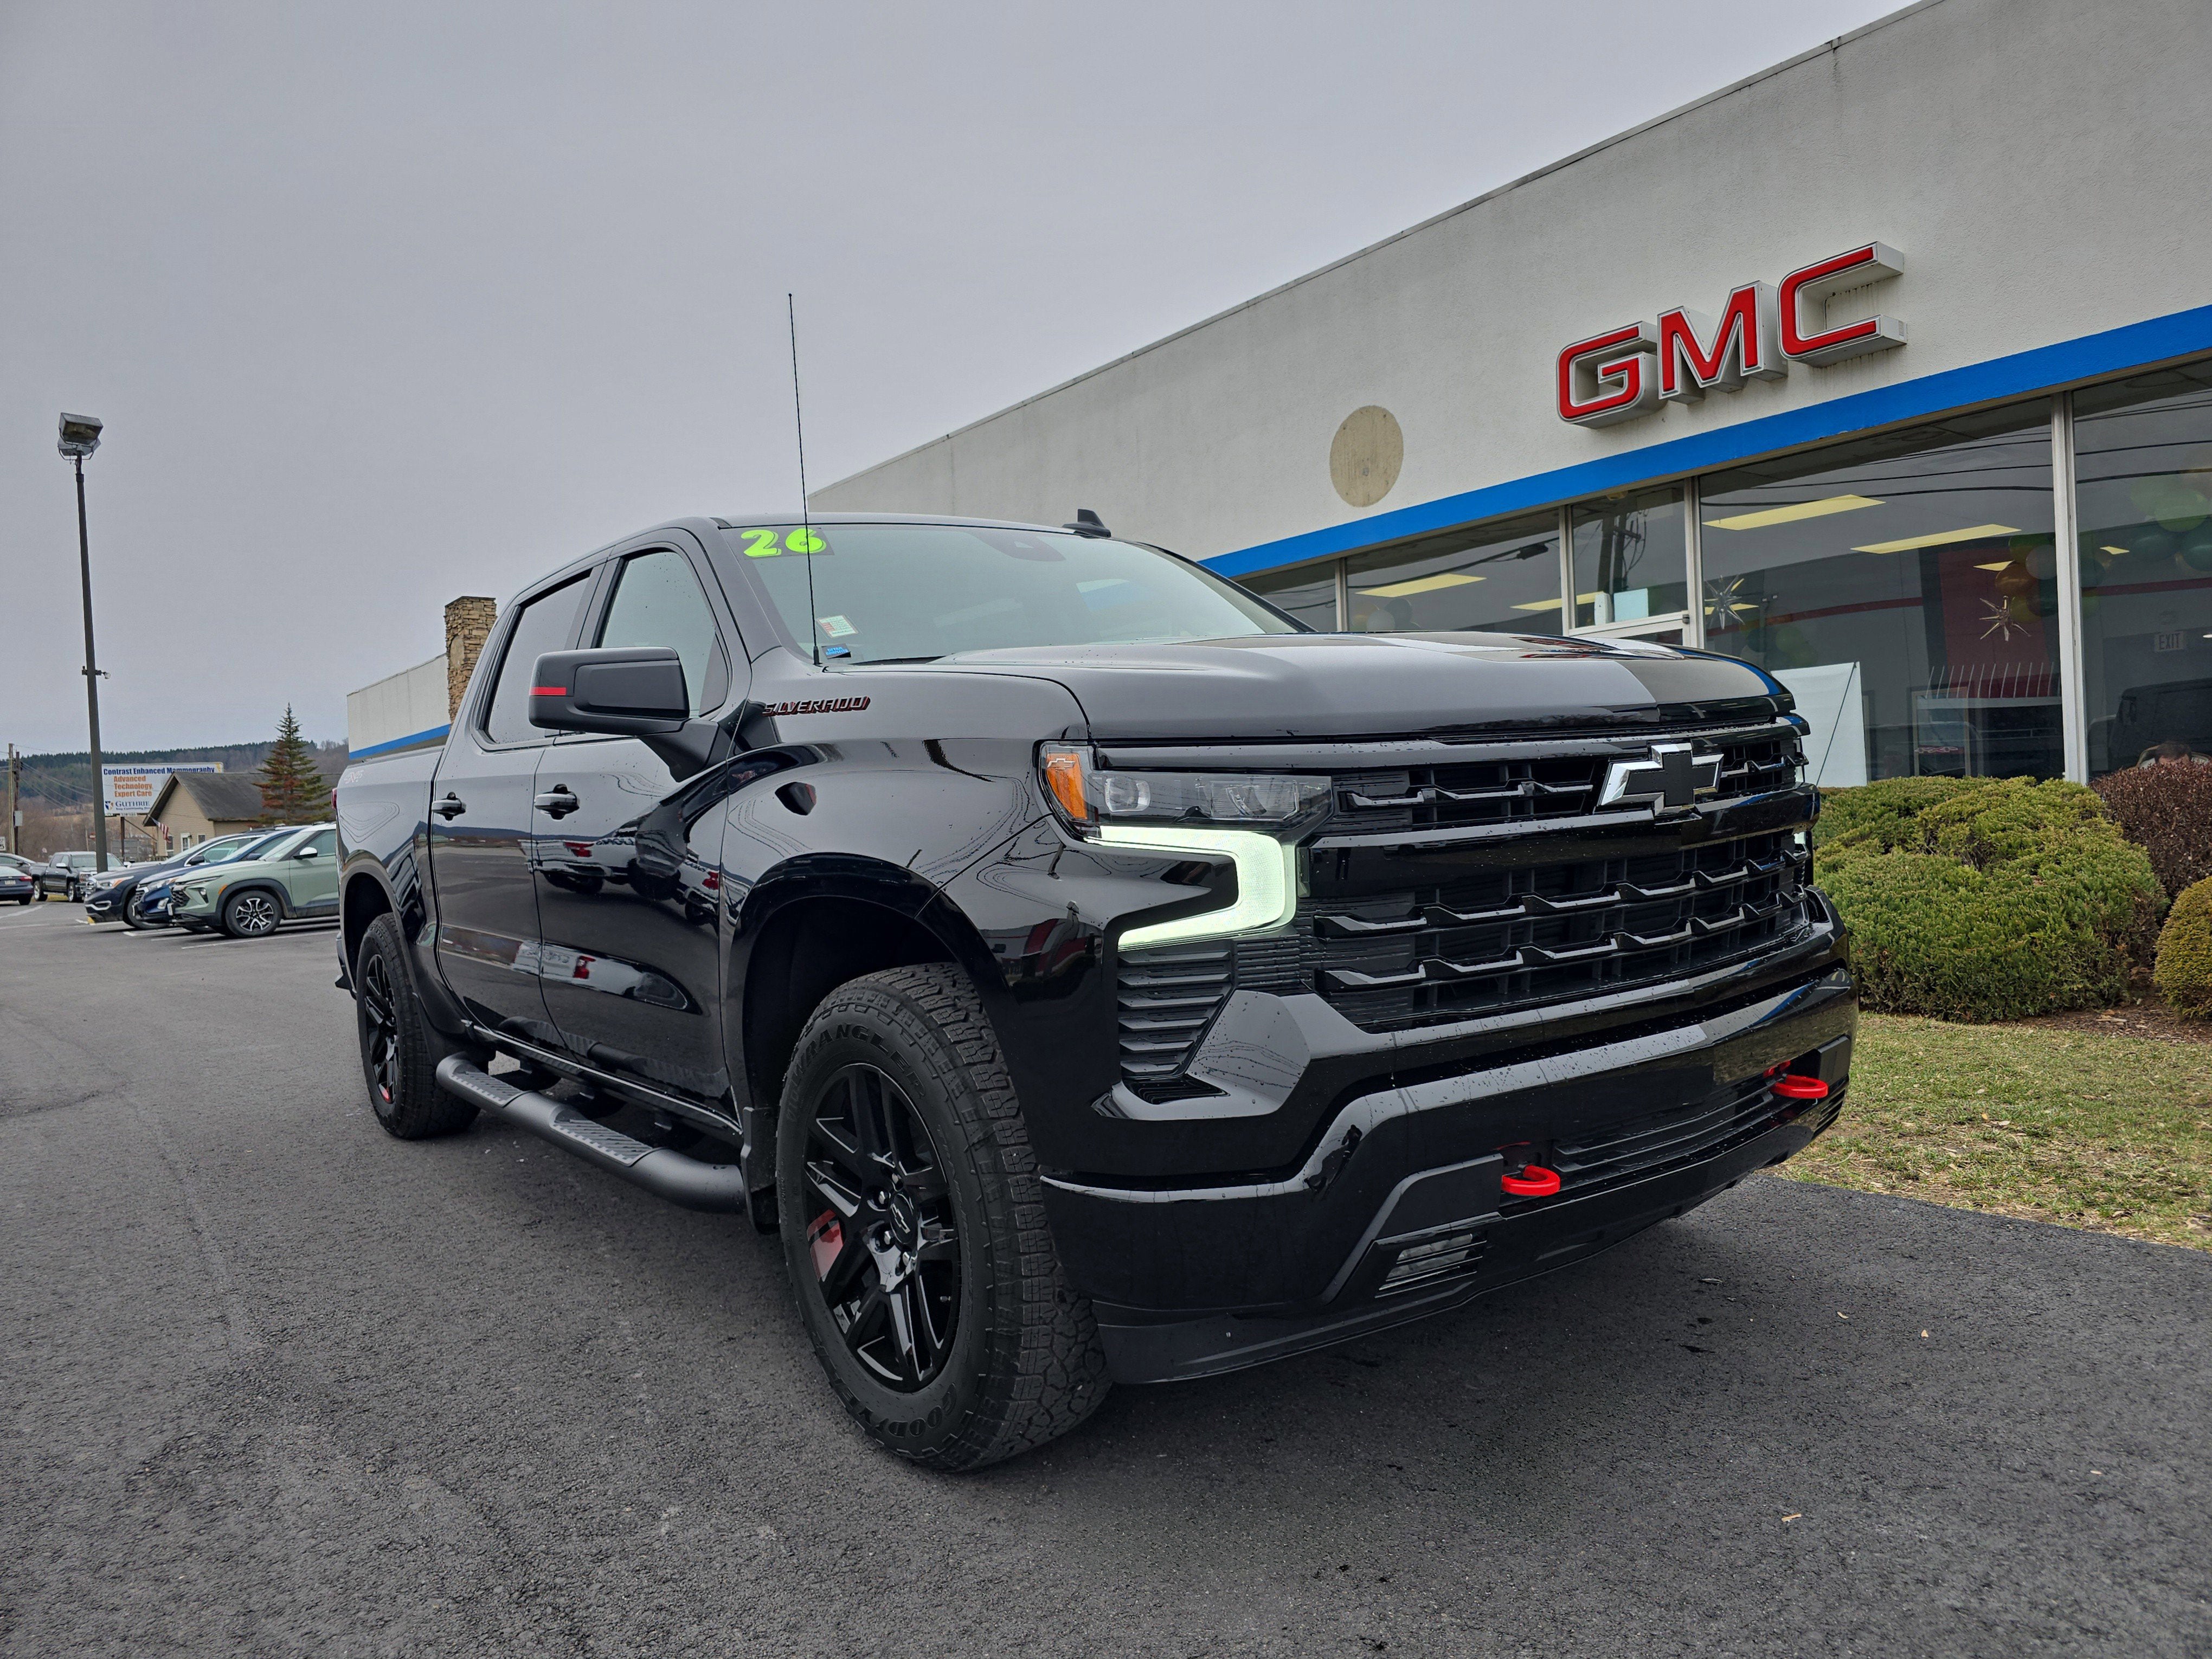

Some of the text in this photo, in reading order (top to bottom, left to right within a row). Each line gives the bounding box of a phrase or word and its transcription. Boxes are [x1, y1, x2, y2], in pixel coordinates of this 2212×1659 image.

[1557, 241, 1907, 429] GMC
[741, 528, 827, 558] 26
[2159, 632, 2180, 650] EXIT
[762, 696, 871, 717] SILVERADO
[788, 1023, 925, 1097] WRANGLER
